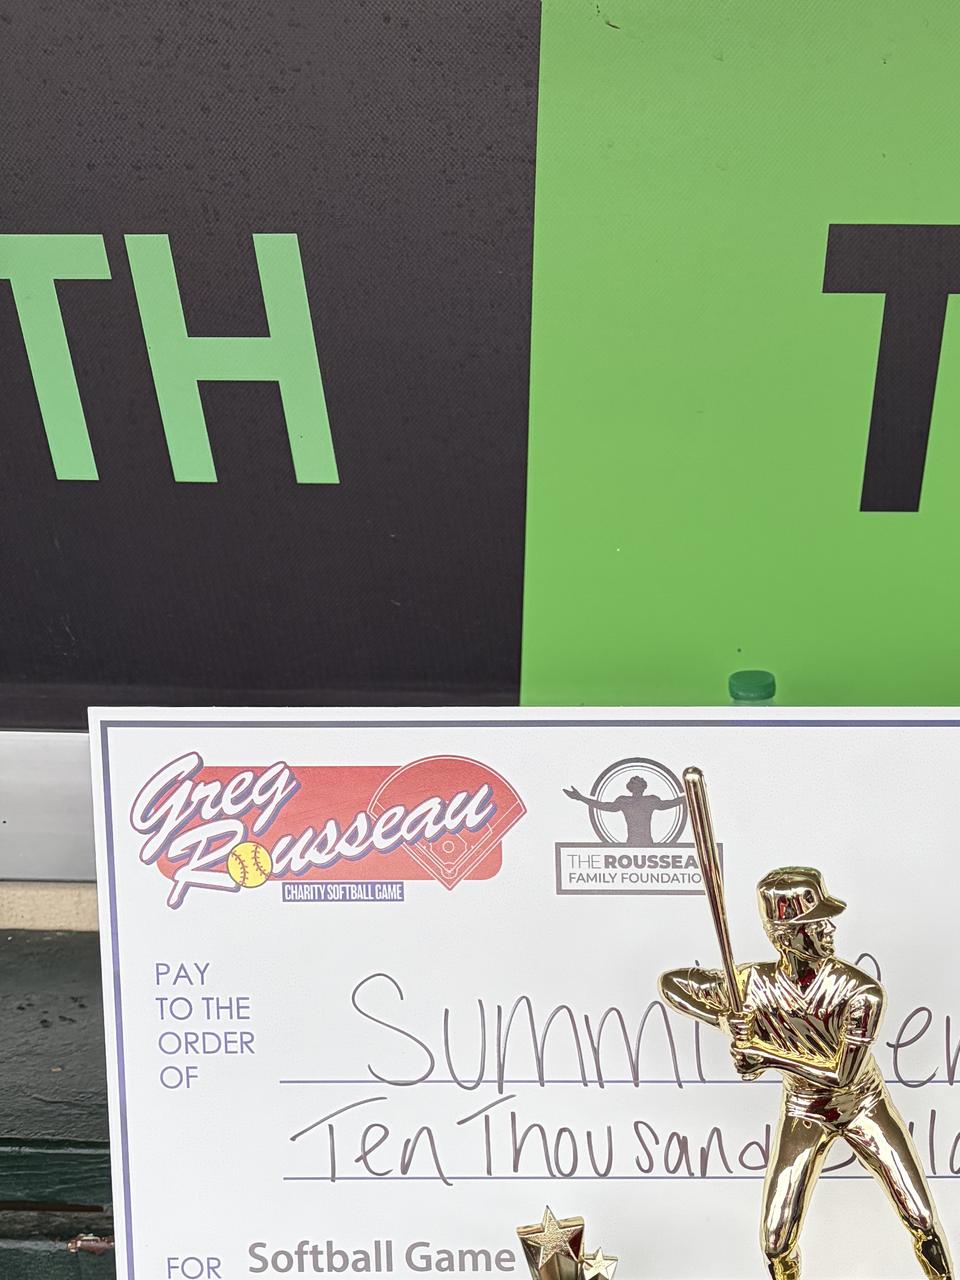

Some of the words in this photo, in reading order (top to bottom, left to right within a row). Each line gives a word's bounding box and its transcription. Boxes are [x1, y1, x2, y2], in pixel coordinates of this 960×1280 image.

[130, 751, 302, 865] Greg
[567, 854, 601, 869] THE
[604, 855, 699, 869] ROUSSEA
[569, 873, 617, 884] FAMILY
[621, 873, 702, 884] FOUNDATIO
[285, 884, 325, 900] CHARITY
[327, 884, 373, 900] SOFTBALL
[375, 884, 403, 900] GAME
[156, 963, 209, 985] PAY
[155, 997, 193, 1020] TO
[202, 997, 250, 1020] THE
[352, 960, 706, 1094] Summi
[159, 1032, 255, 1054] ORDER
[160, 1066, 198, 1089] OF
[290, 1097, 454, 1186] Ten
[167, 1257, 222, 1279] FOR
[249, 1240, 393, 1273] Softball
[405, 1242, 515, 1273] Game
